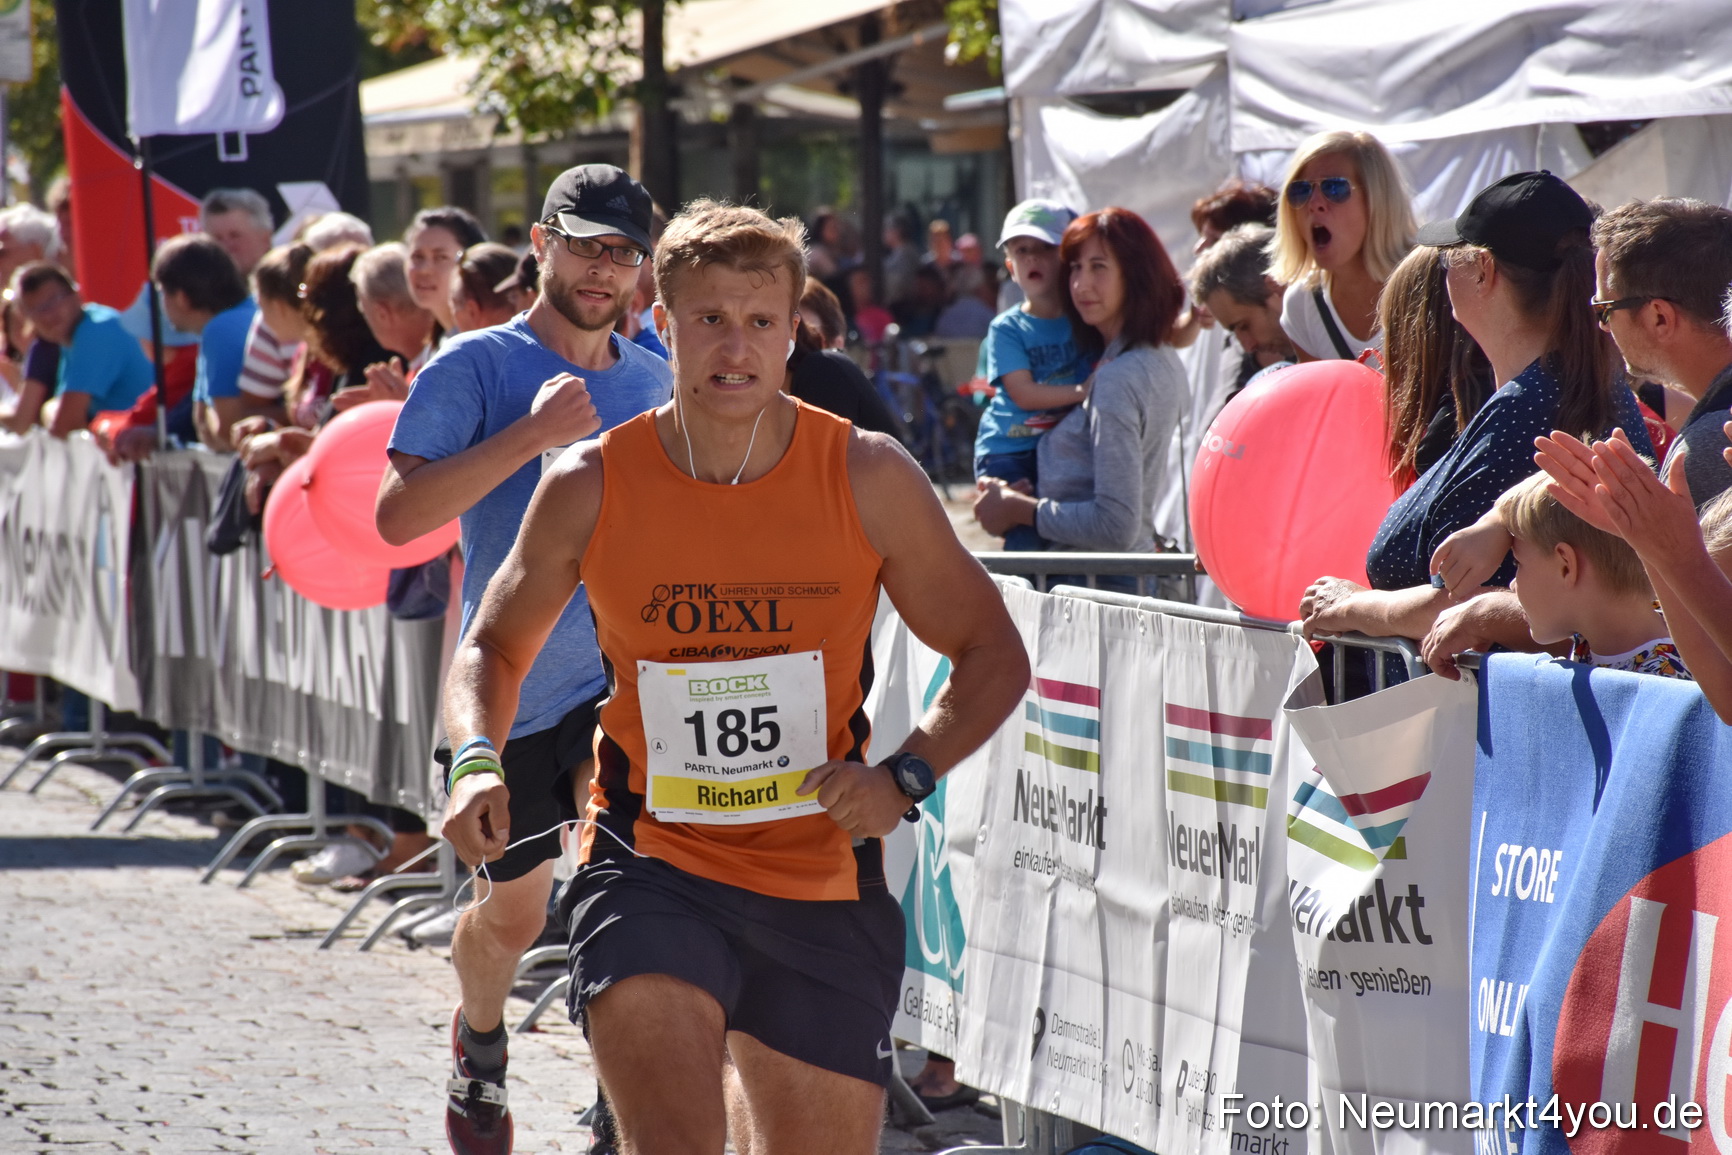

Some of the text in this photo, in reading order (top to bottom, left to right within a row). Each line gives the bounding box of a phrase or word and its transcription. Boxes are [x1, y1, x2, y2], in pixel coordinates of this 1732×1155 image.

[720, 586, 758, 596] UHREN
[761, 585, 784, 596] UND
[787, 585, 841, 596] SCHMUCK
[666, 599, 793, 634] OEXL
[688, 673, 770, 696] BOCK
[724, 693, 743, 701] smart
[743, 691, 772, 700] concepts
[655, 741, 663, 751] A
[684, 705, 781, 758] 185
[684, 761, 774, 776] PARTL Neumarkt
[697, 780, 779, 808] Richard
[1491, 842, 1563, 904] STORE
[1306, 959, 1342, 990] leben
[1350, 966, 1432, 997] genießen
[1477, 977, 1530, 1038] ONLI
[1046, 1044, 1087, 1079] Neumarkt
